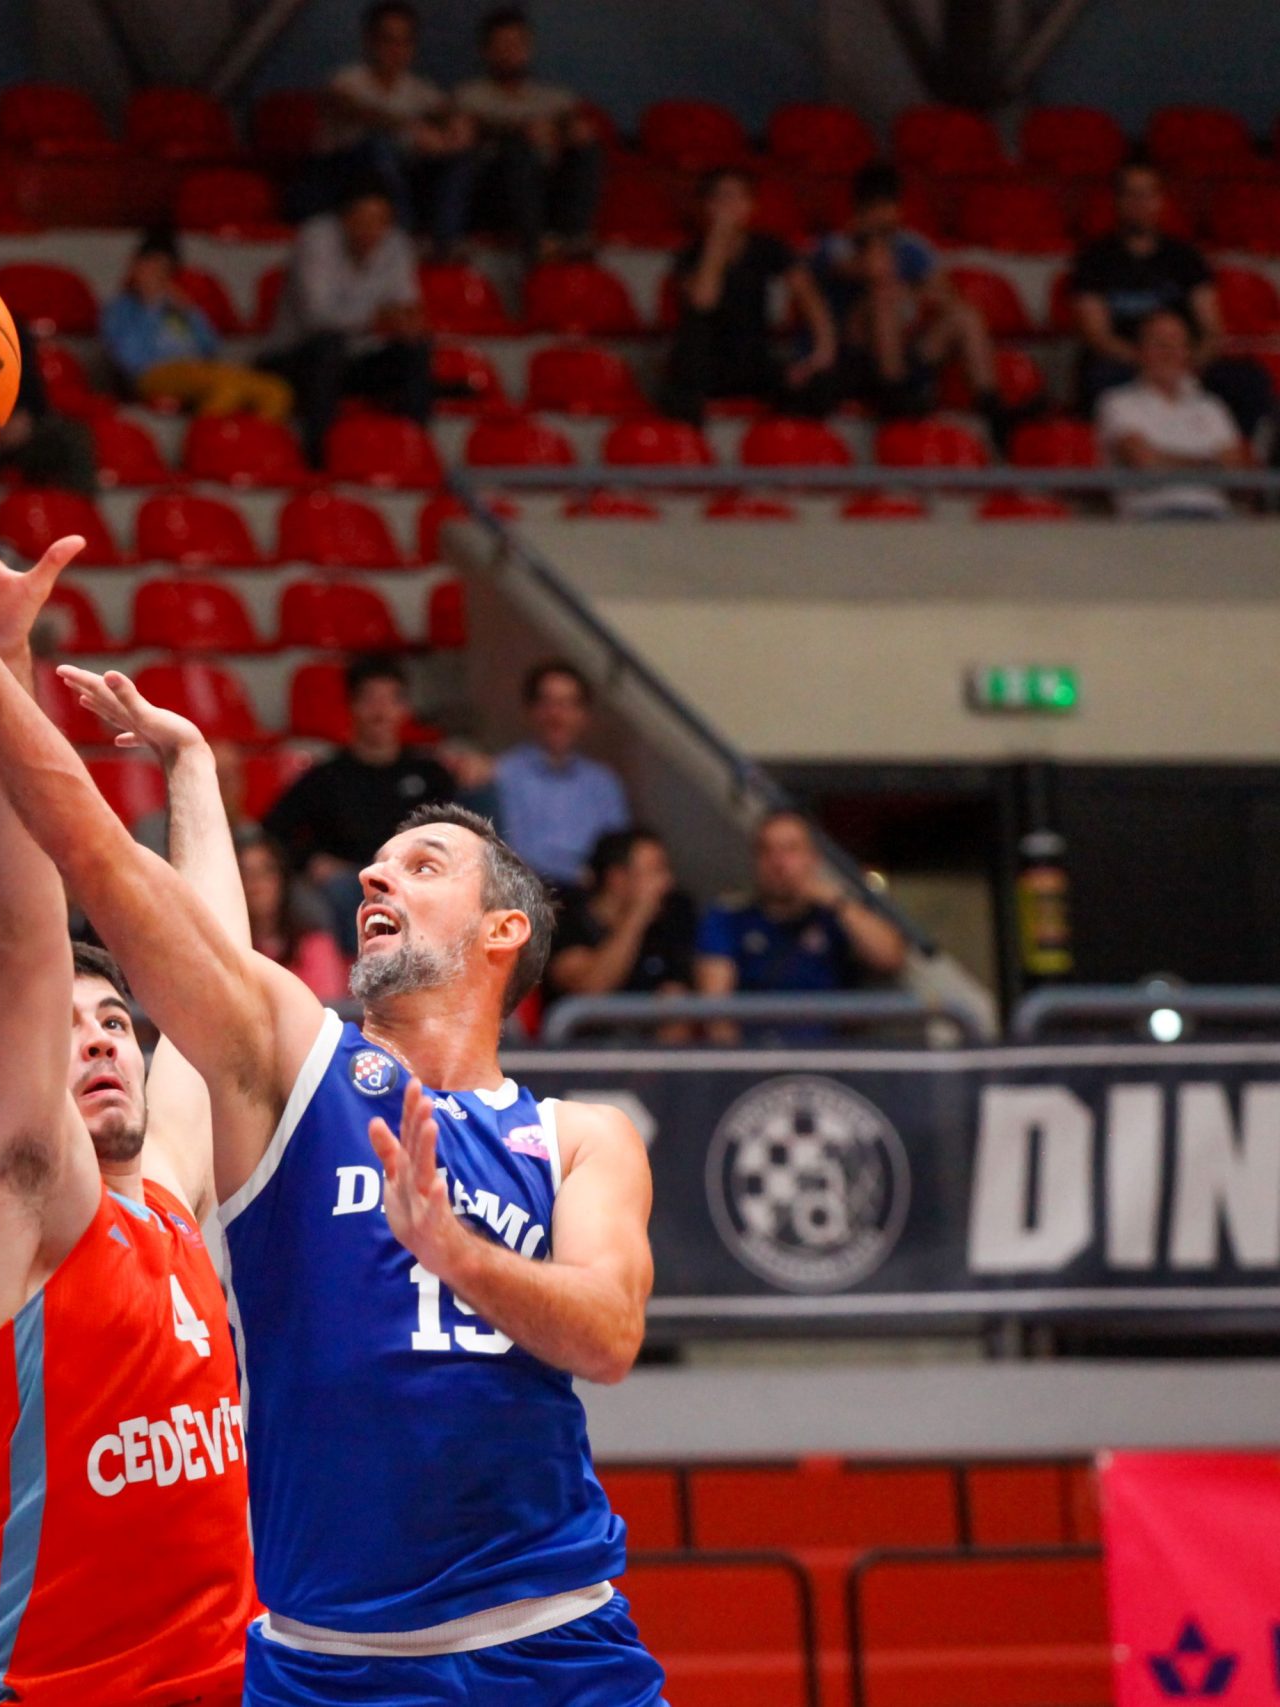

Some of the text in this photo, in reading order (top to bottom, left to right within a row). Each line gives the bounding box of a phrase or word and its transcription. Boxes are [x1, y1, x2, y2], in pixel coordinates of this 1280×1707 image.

[332, 1165, 545, 1260] DAM
[967, 1083, 1280, 1274] DIN
[169, 1274, 210, 1357] 4
